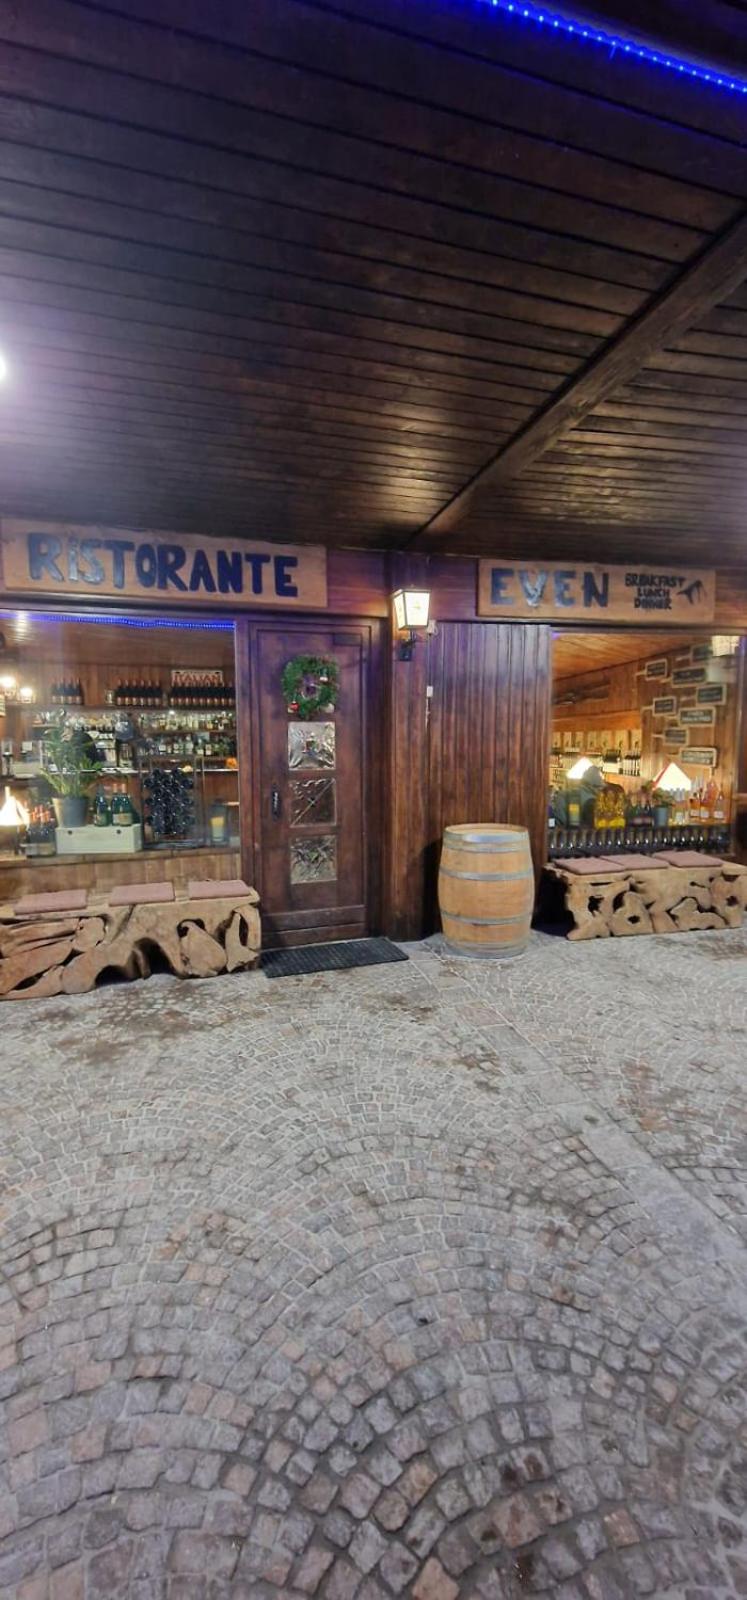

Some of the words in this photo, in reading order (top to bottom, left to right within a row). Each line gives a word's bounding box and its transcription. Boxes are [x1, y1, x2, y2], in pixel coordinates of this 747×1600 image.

[491, 567, 609, 608] EVEN
[624, 573, 685, 588] BREAKFAST
[637, 588, 670, 598] LUNCH
[634, 597, 672, 610] DINNER
